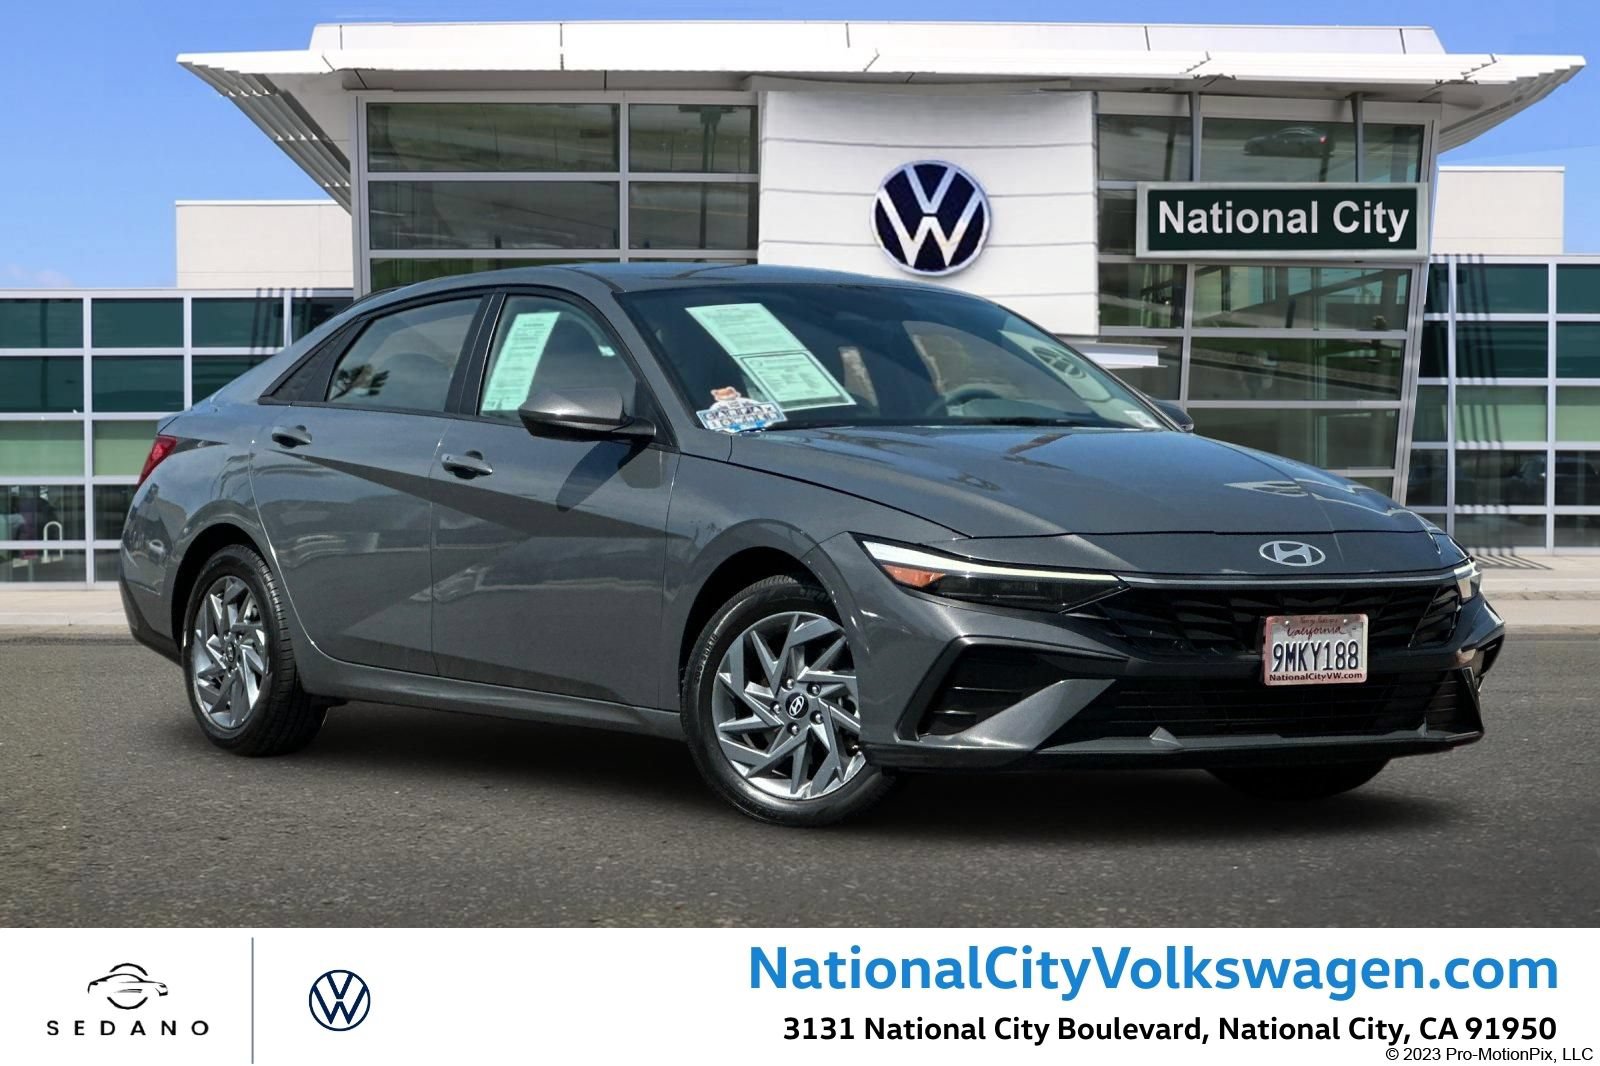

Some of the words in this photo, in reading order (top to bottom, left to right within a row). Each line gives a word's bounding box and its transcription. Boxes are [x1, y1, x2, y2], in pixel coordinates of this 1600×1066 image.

[1159, 200, 1318, 234] National
[1333, 200, 1411, 243] City
[1287, 626, 1347, 640] California
[1272, 640, 1359, 672] 9MKY188
[1269, 672, 1363, 682] NationalCityVW.com
